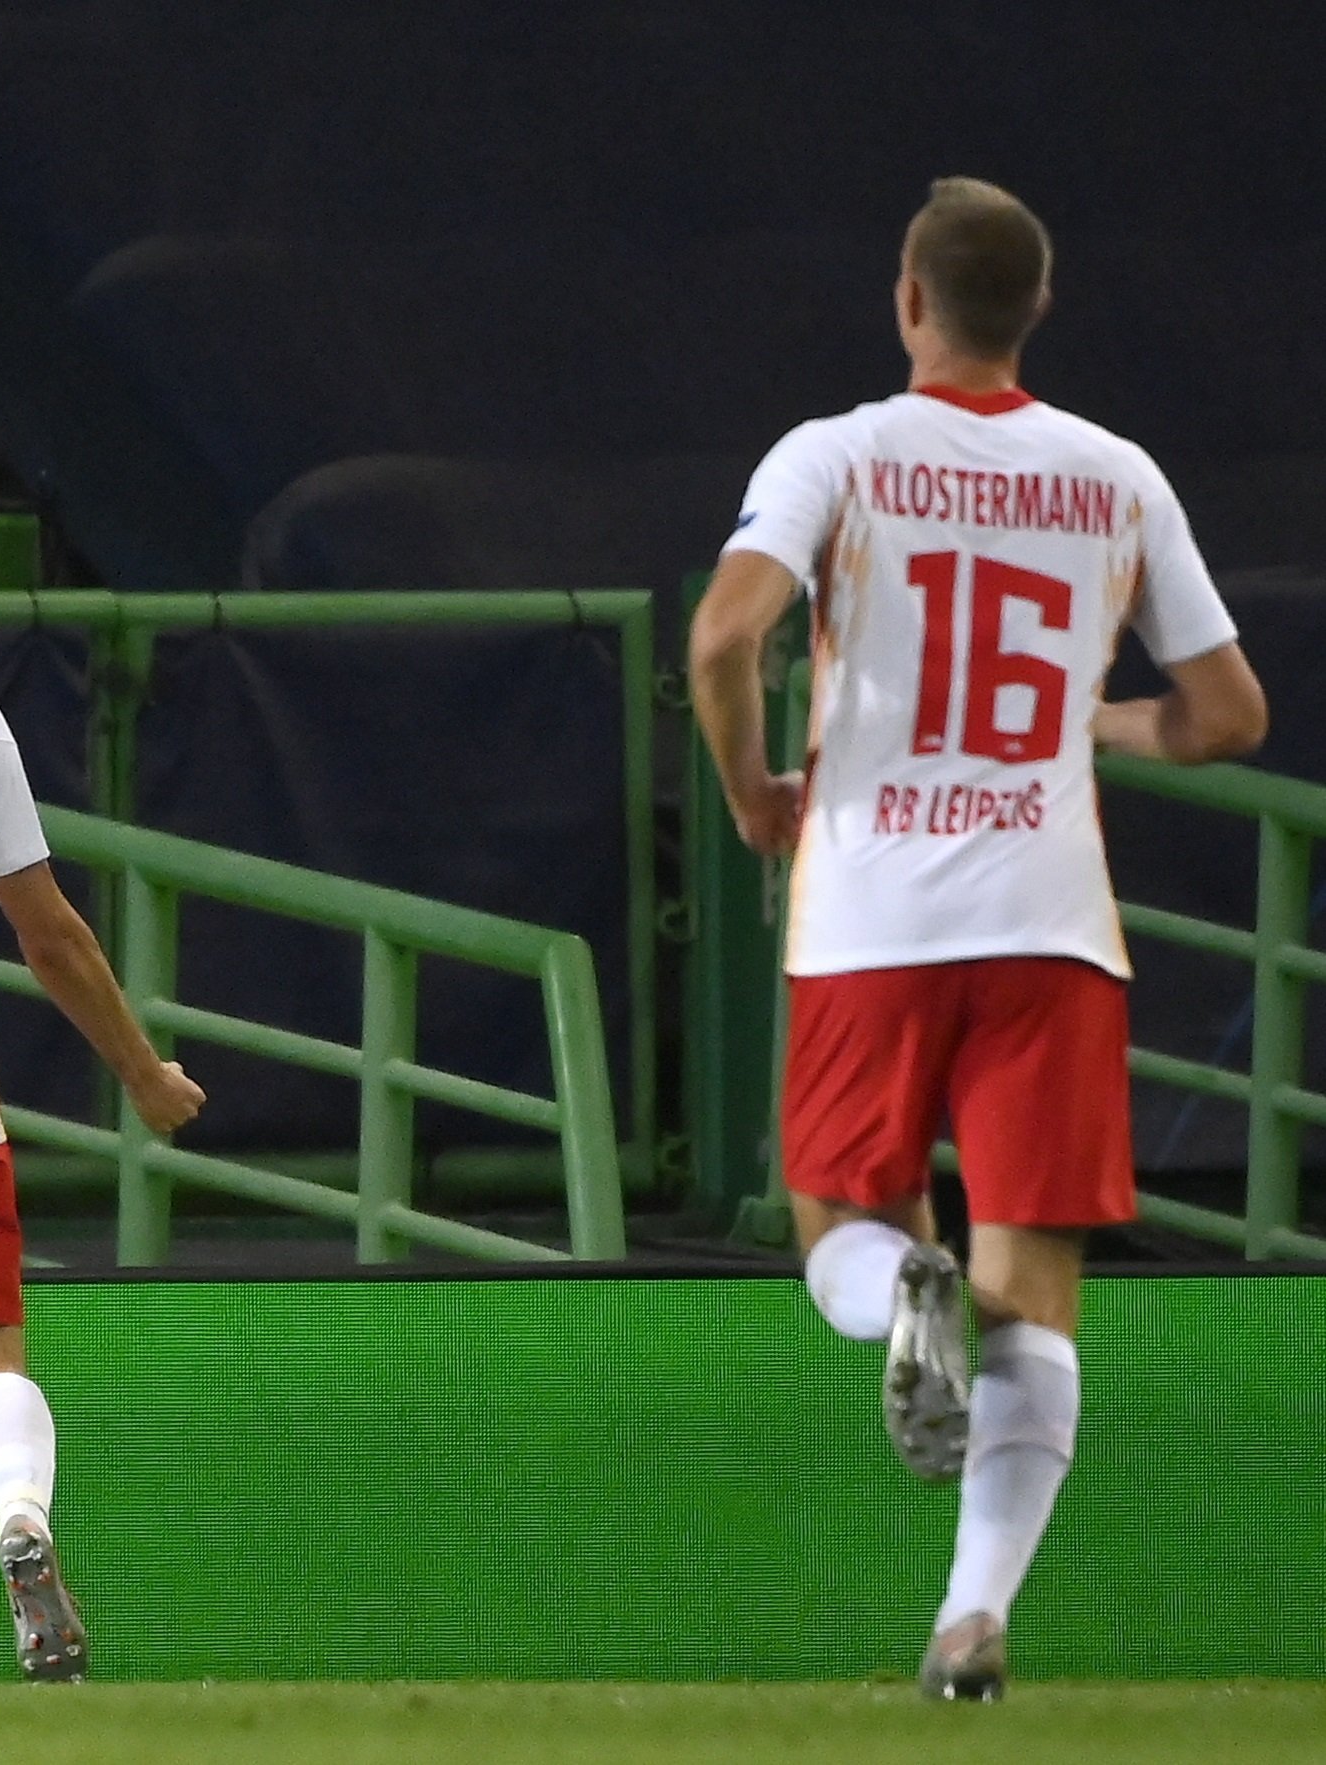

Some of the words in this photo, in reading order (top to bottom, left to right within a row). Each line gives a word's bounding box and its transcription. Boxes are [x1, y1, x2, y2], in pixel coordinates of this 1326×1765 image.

[872, 458, 1116, 537] KLOSTERMANN
[907, 550, 1073, 765] 16
[874, 783, 920, 835] RB
[928, 779, 1045, 836] LEIPZIG
